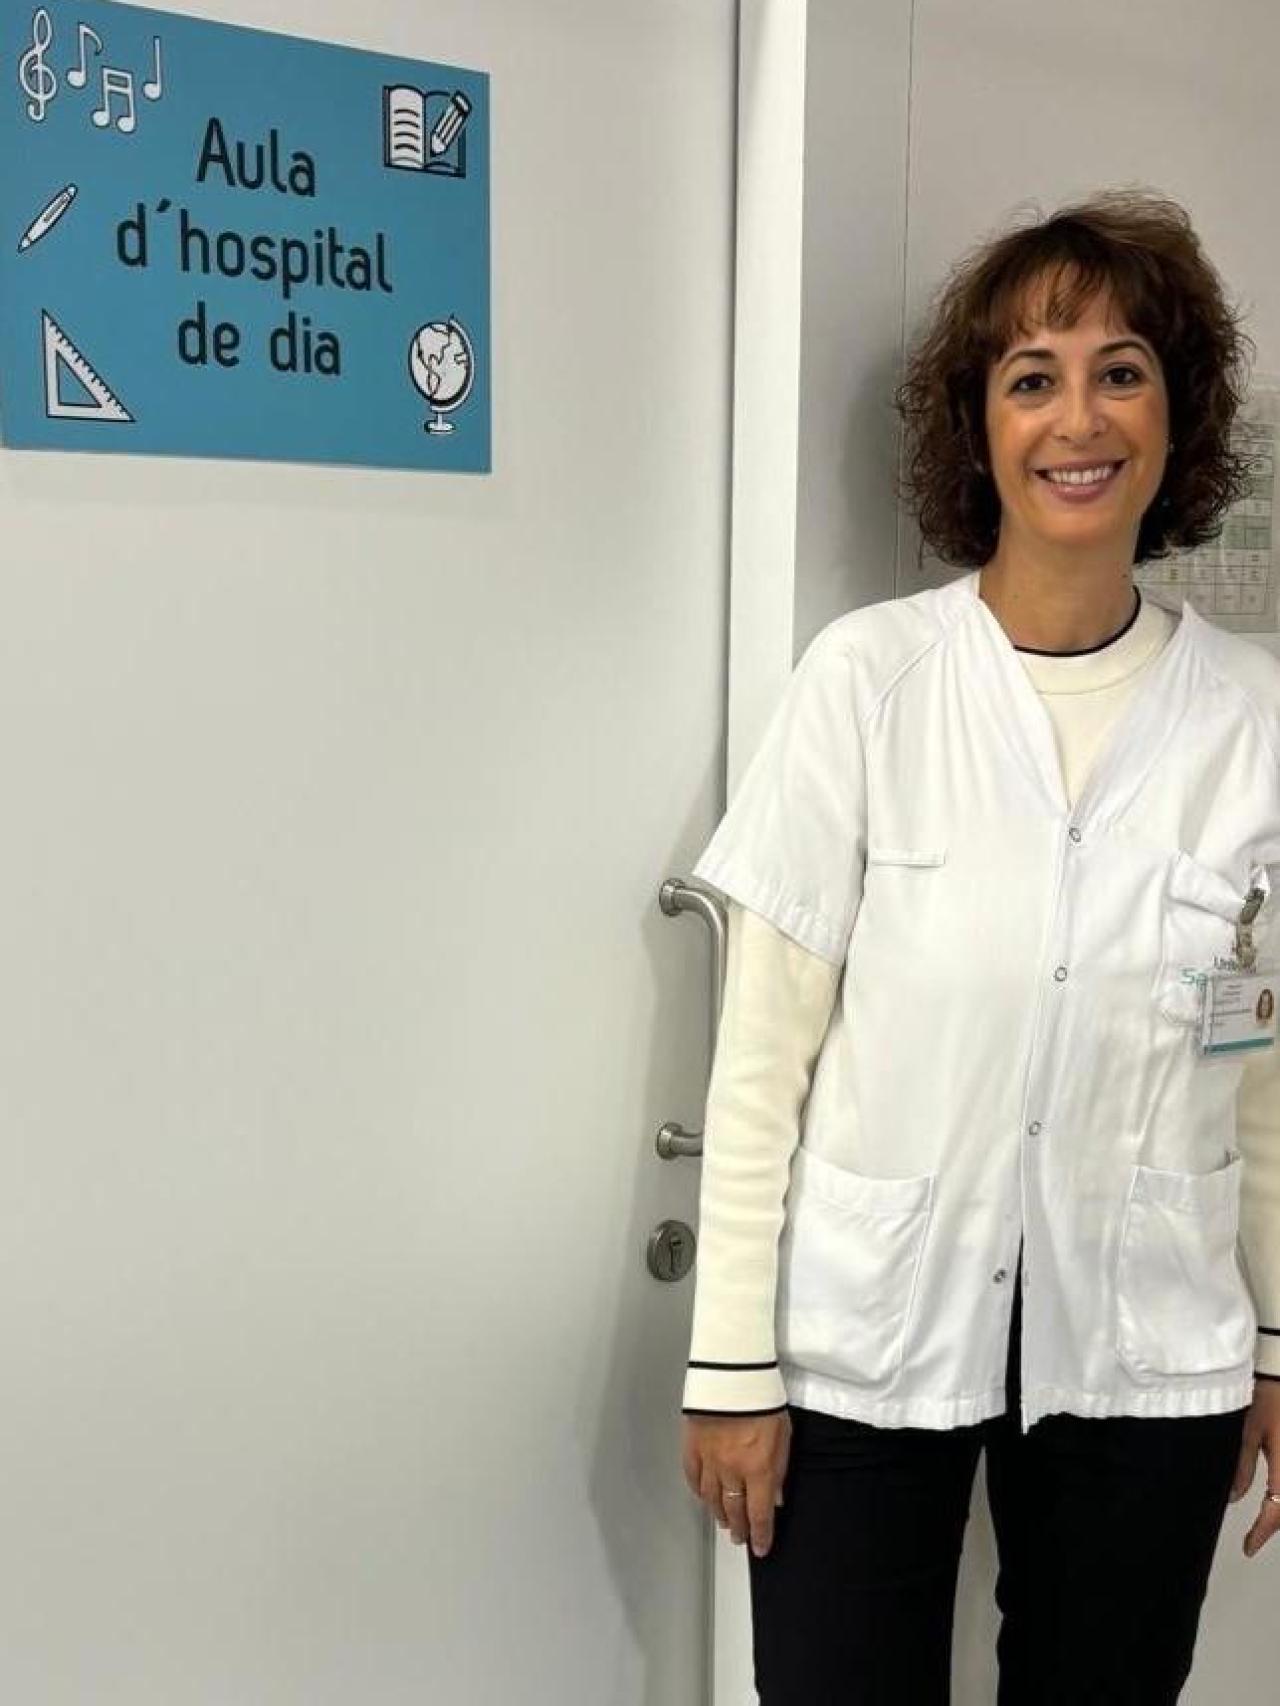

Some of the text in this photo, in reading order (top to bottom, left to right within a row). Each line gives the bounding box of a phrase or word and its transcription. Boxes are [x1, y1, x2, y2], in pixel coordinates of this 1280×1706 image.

[195, 116, 317, 198] Aula
[177, 300, 342, 377] de dia
